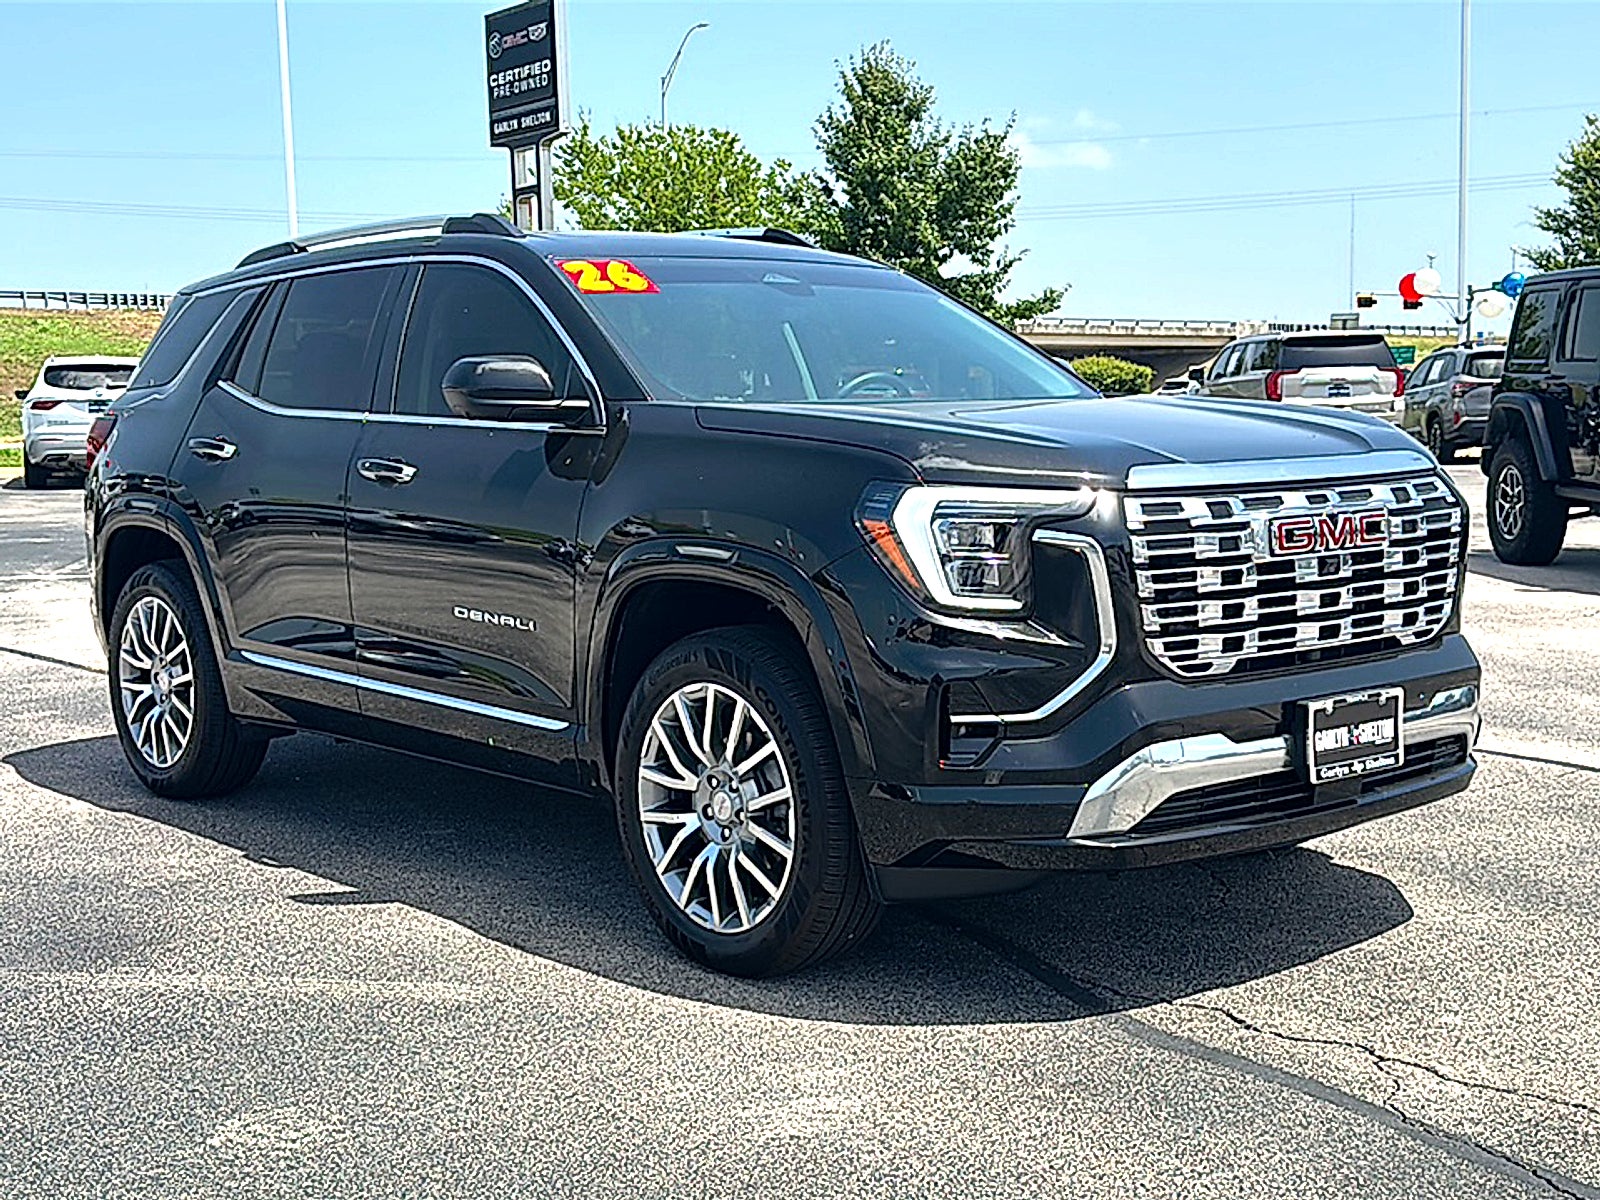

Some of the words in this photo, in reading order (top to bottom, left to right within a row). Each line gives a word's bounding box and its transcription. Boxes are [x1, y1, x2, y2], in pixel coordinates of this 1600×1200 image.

[502, 30, 529, 49] GMC
[490, 59, 551, 87] CERTIFIED
[493, 74, 548, 99] PRE-OWNED
[561, 260, 649, 292] 26
[1271, 512, 1389, 553] GMC
[453, 605, 536, 632] DENALI
